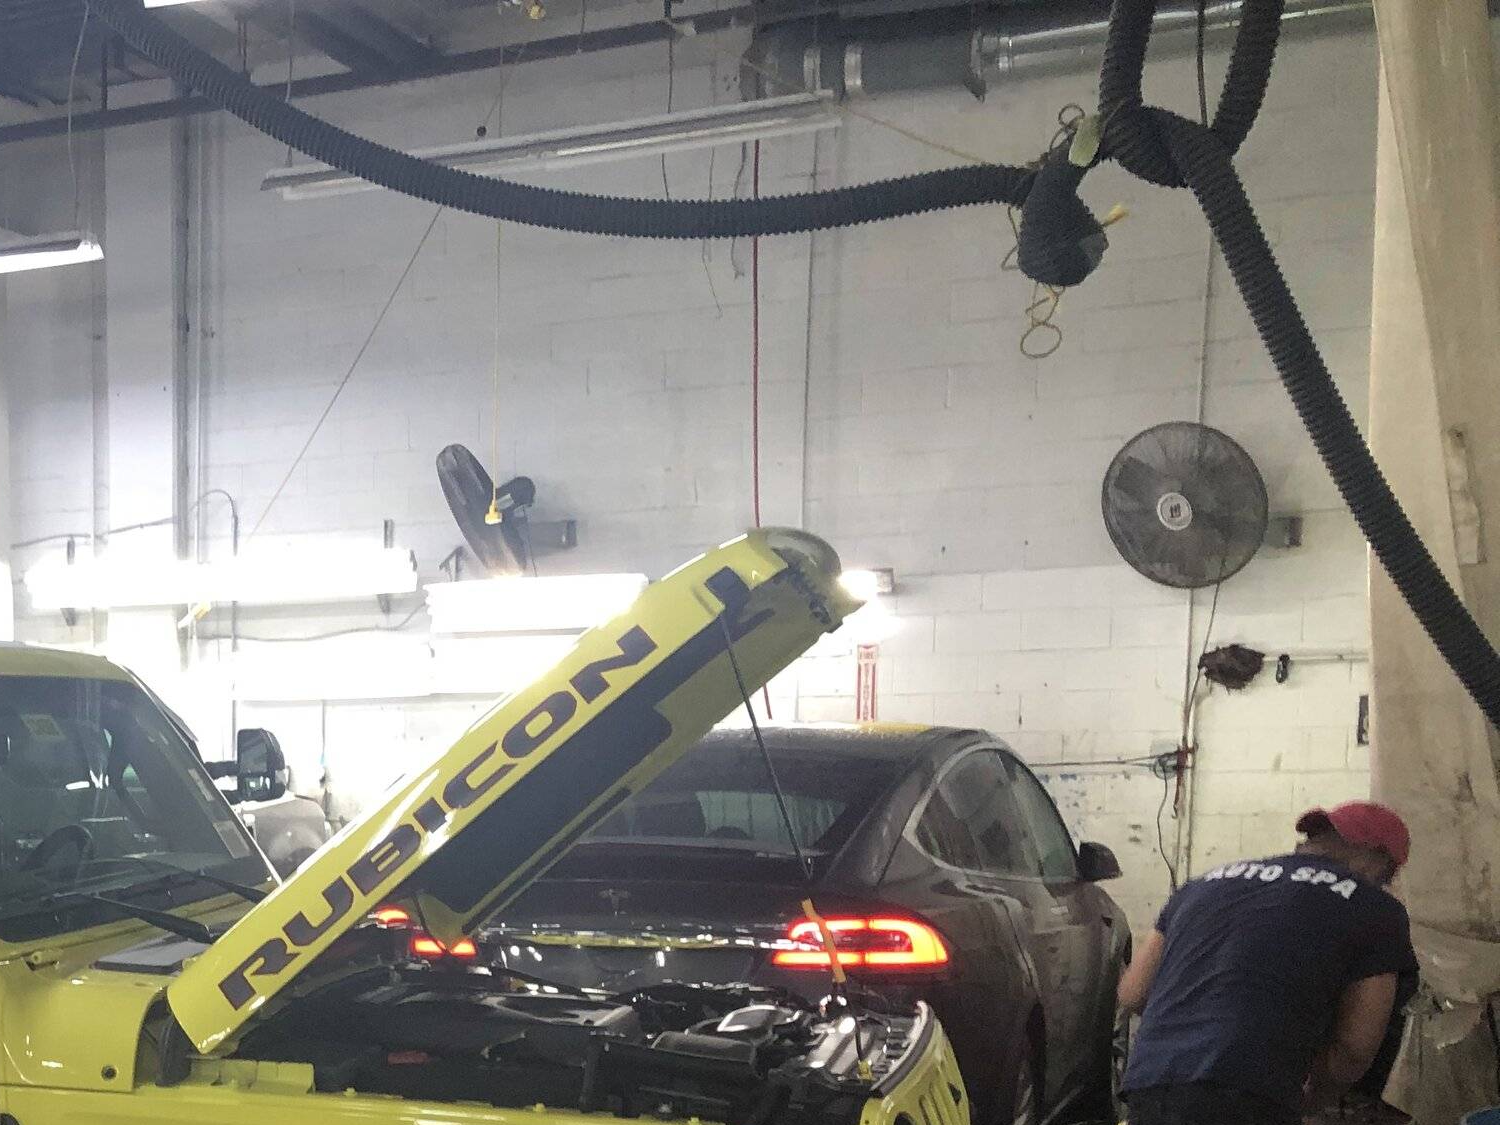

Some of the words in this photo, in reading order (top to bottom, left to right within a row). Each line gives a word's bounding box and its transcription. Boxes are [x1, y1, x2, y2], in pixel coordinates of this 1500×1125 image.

[217, 624, 658, 1012] RUBICON
[1204, 863, 1284, 882] AUTO
[1291, 866, 1357, 900] SPA
